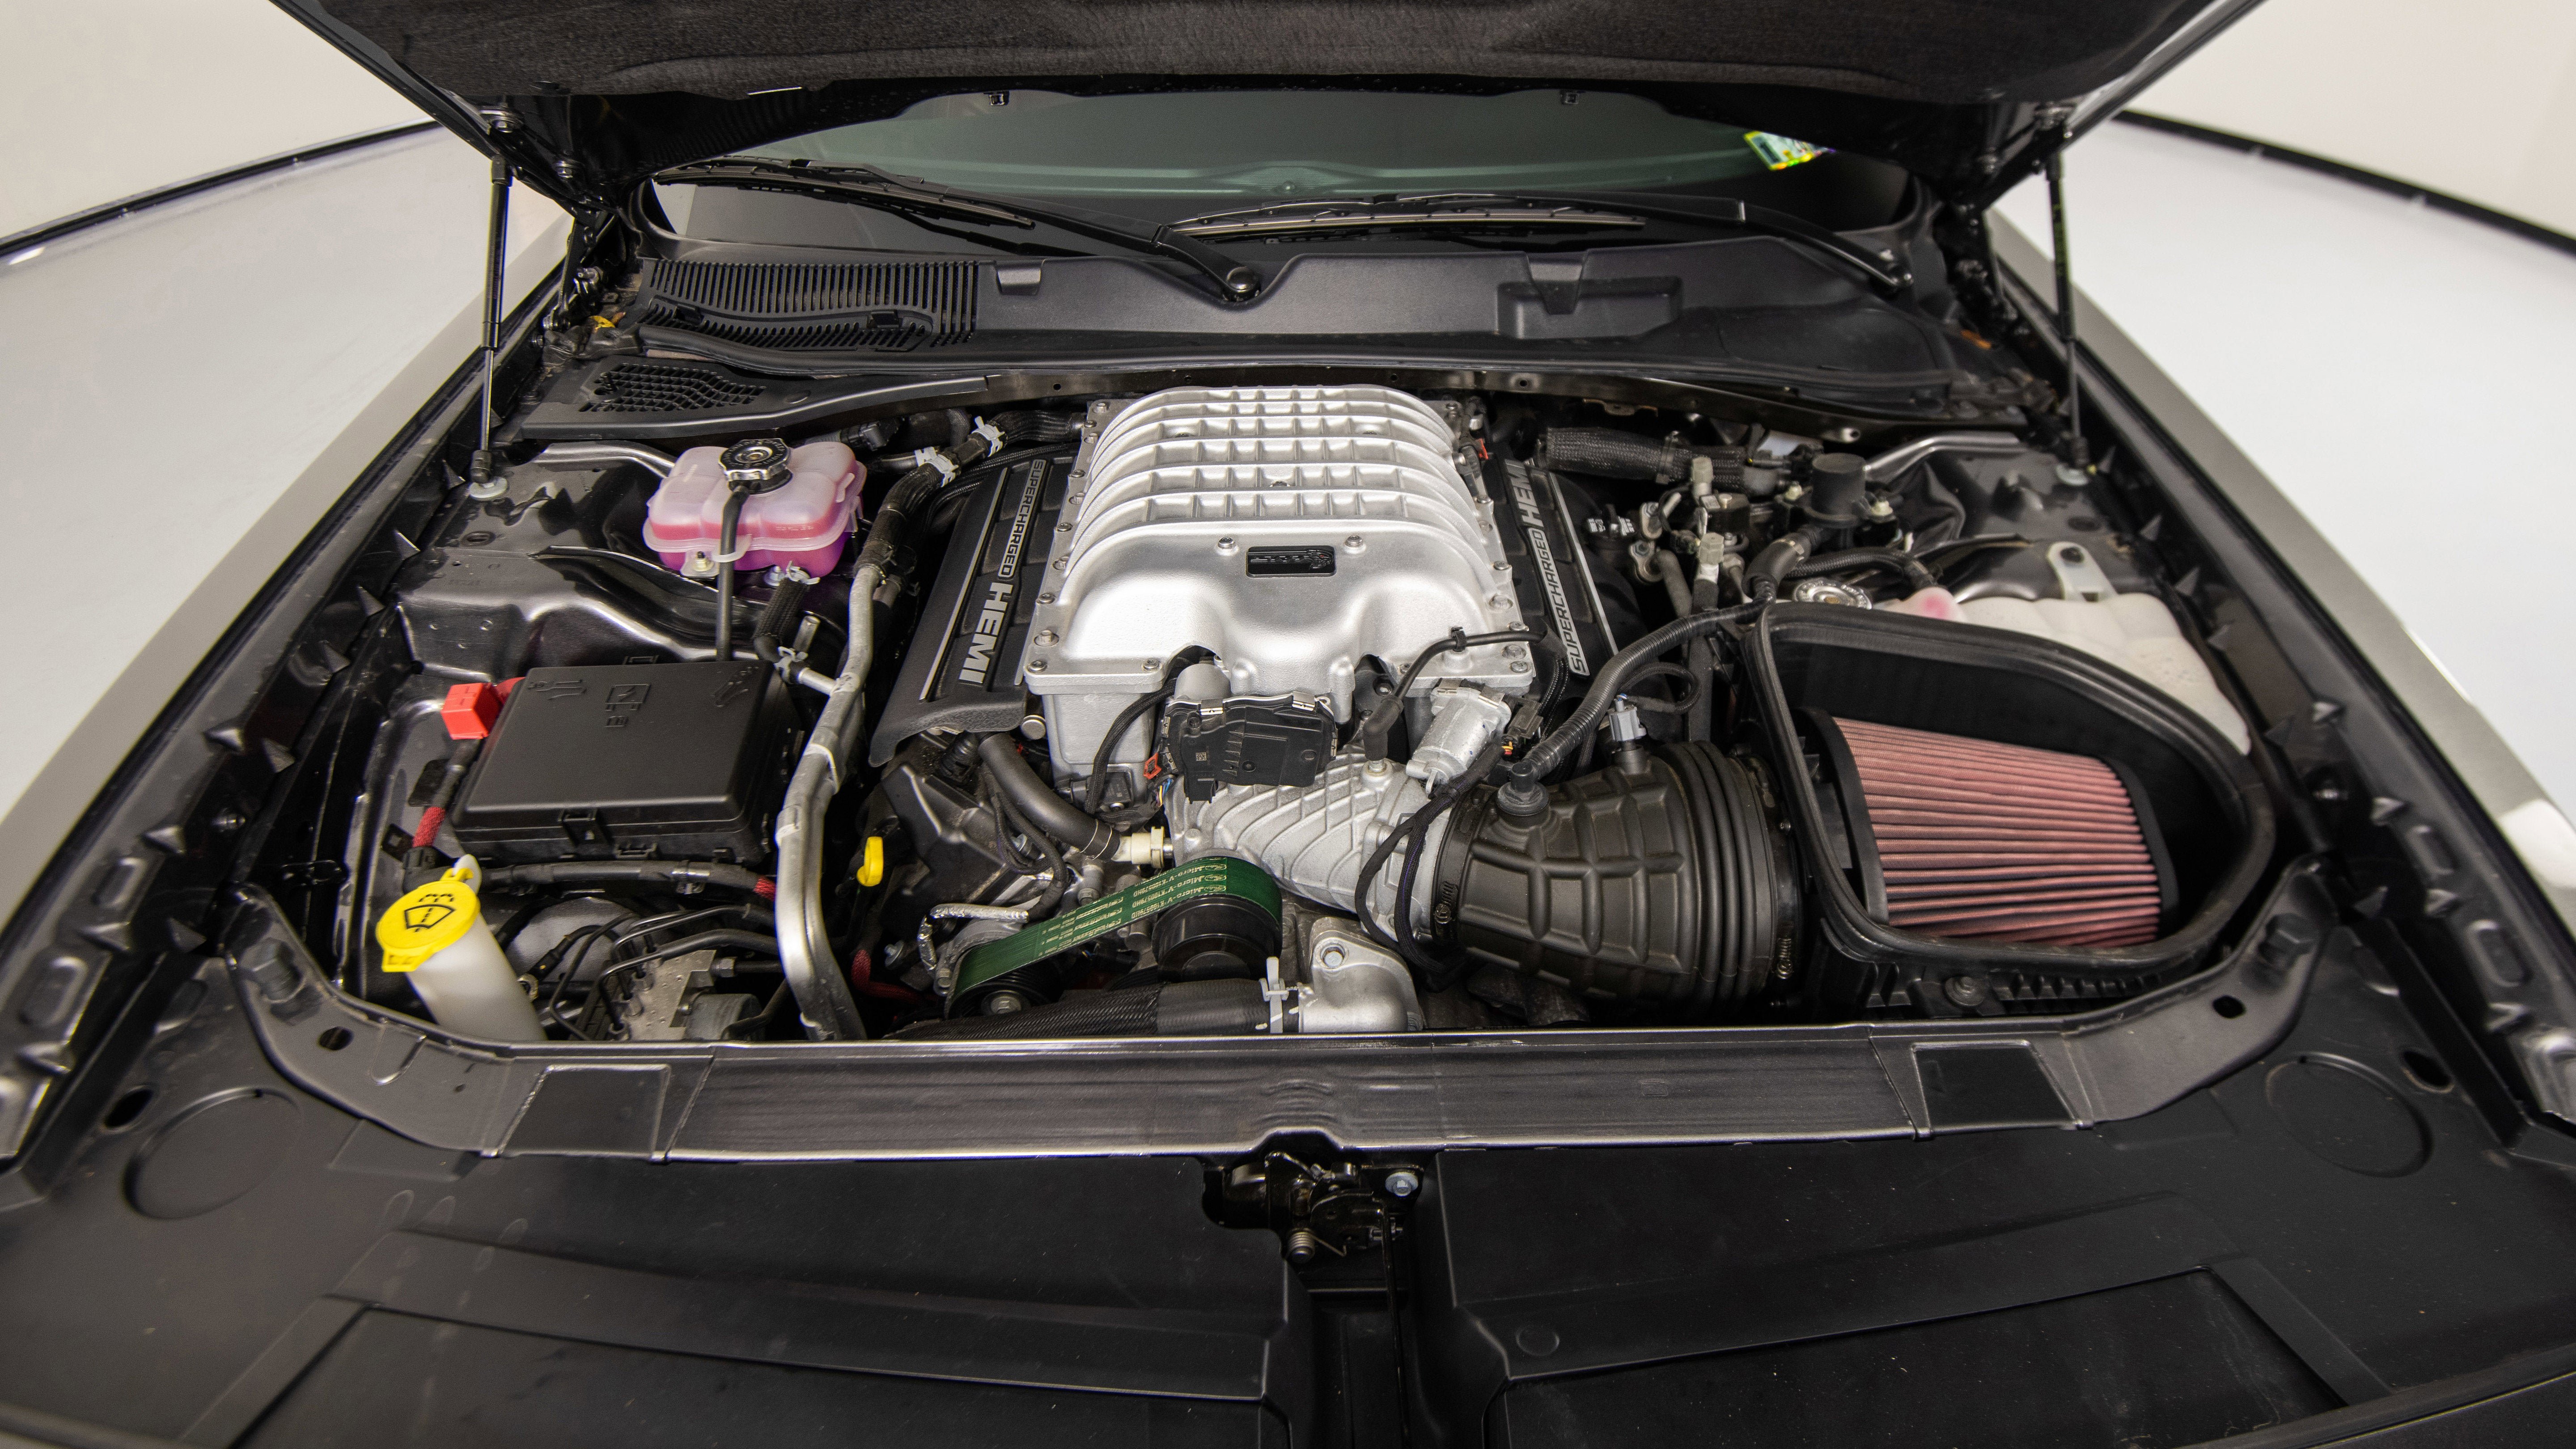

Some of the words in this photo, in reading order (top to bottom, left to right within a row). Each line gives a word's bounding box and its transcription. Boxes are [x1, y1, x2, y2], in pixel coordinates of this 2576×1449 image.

[1000, 461, 1045, 576] SUPERCHARGED
[1505, 459, 1544, 528] HEMI
[959, 582, 1013, 684] HEMI
[1531, 530, 1587, 674] SUPERCHARGED
